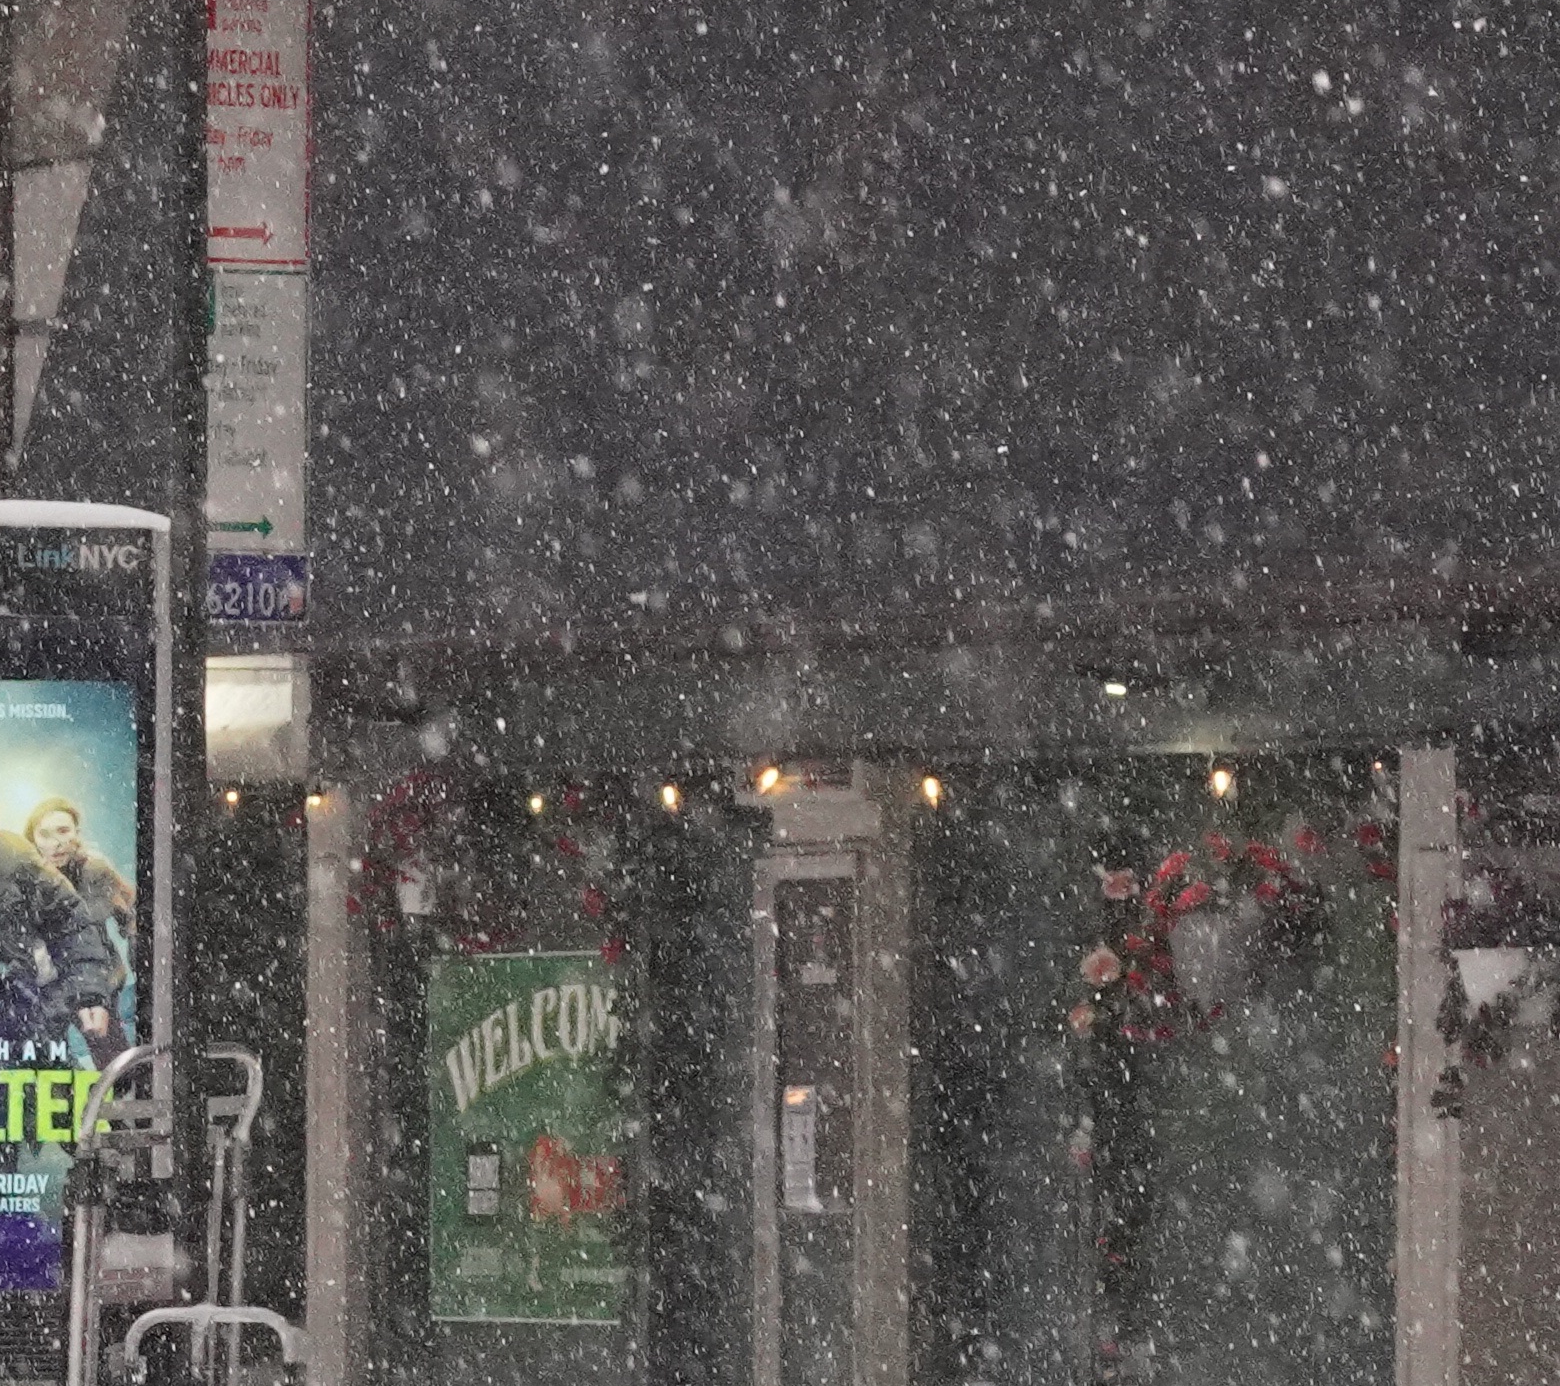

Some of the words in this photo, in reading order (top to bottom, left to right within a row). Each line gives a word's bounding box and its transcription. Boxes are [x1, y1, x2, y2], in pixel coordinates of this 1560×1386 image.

[207, 50, 282, 78] MERCIAL
[207, 84, 255, 108] ICLES
[260, 83, 300, 109] ONLY
[20, 543, 142, 569] LinkNYC
[446, 983, 618, 1113] WELCOM
